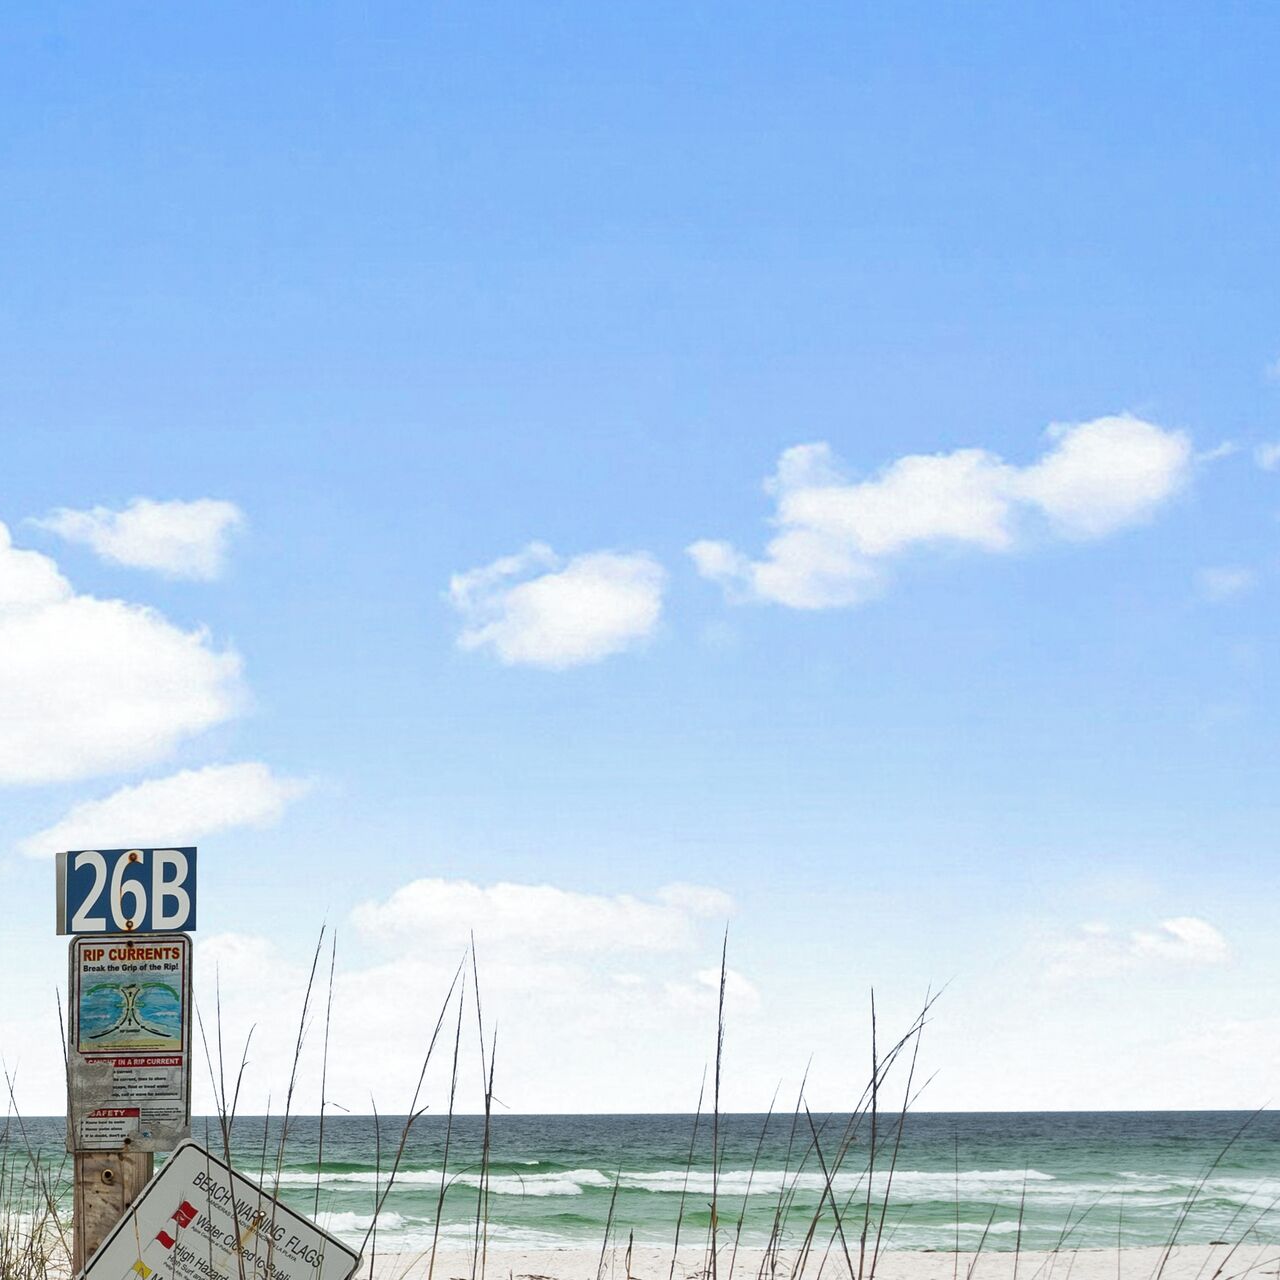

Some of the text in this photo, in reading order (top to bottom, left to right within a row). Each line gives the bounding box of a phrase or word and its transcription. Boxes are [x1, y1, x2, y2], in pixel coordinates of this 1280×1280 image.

[72, 850, 190, 932] 26B
[84, 947, 180, 961] RIP CURRENTS
[122, 964, 138, 972] Grip
[164, 963, 178, 971] Rip!
[191, 1171, 325, 1268] BEACH WARNING FLAGS
[194, 1214, 226, 1240] Water
[172, 1242, 197, 1264] High
[180, 1263, 194, 1275] Surf
